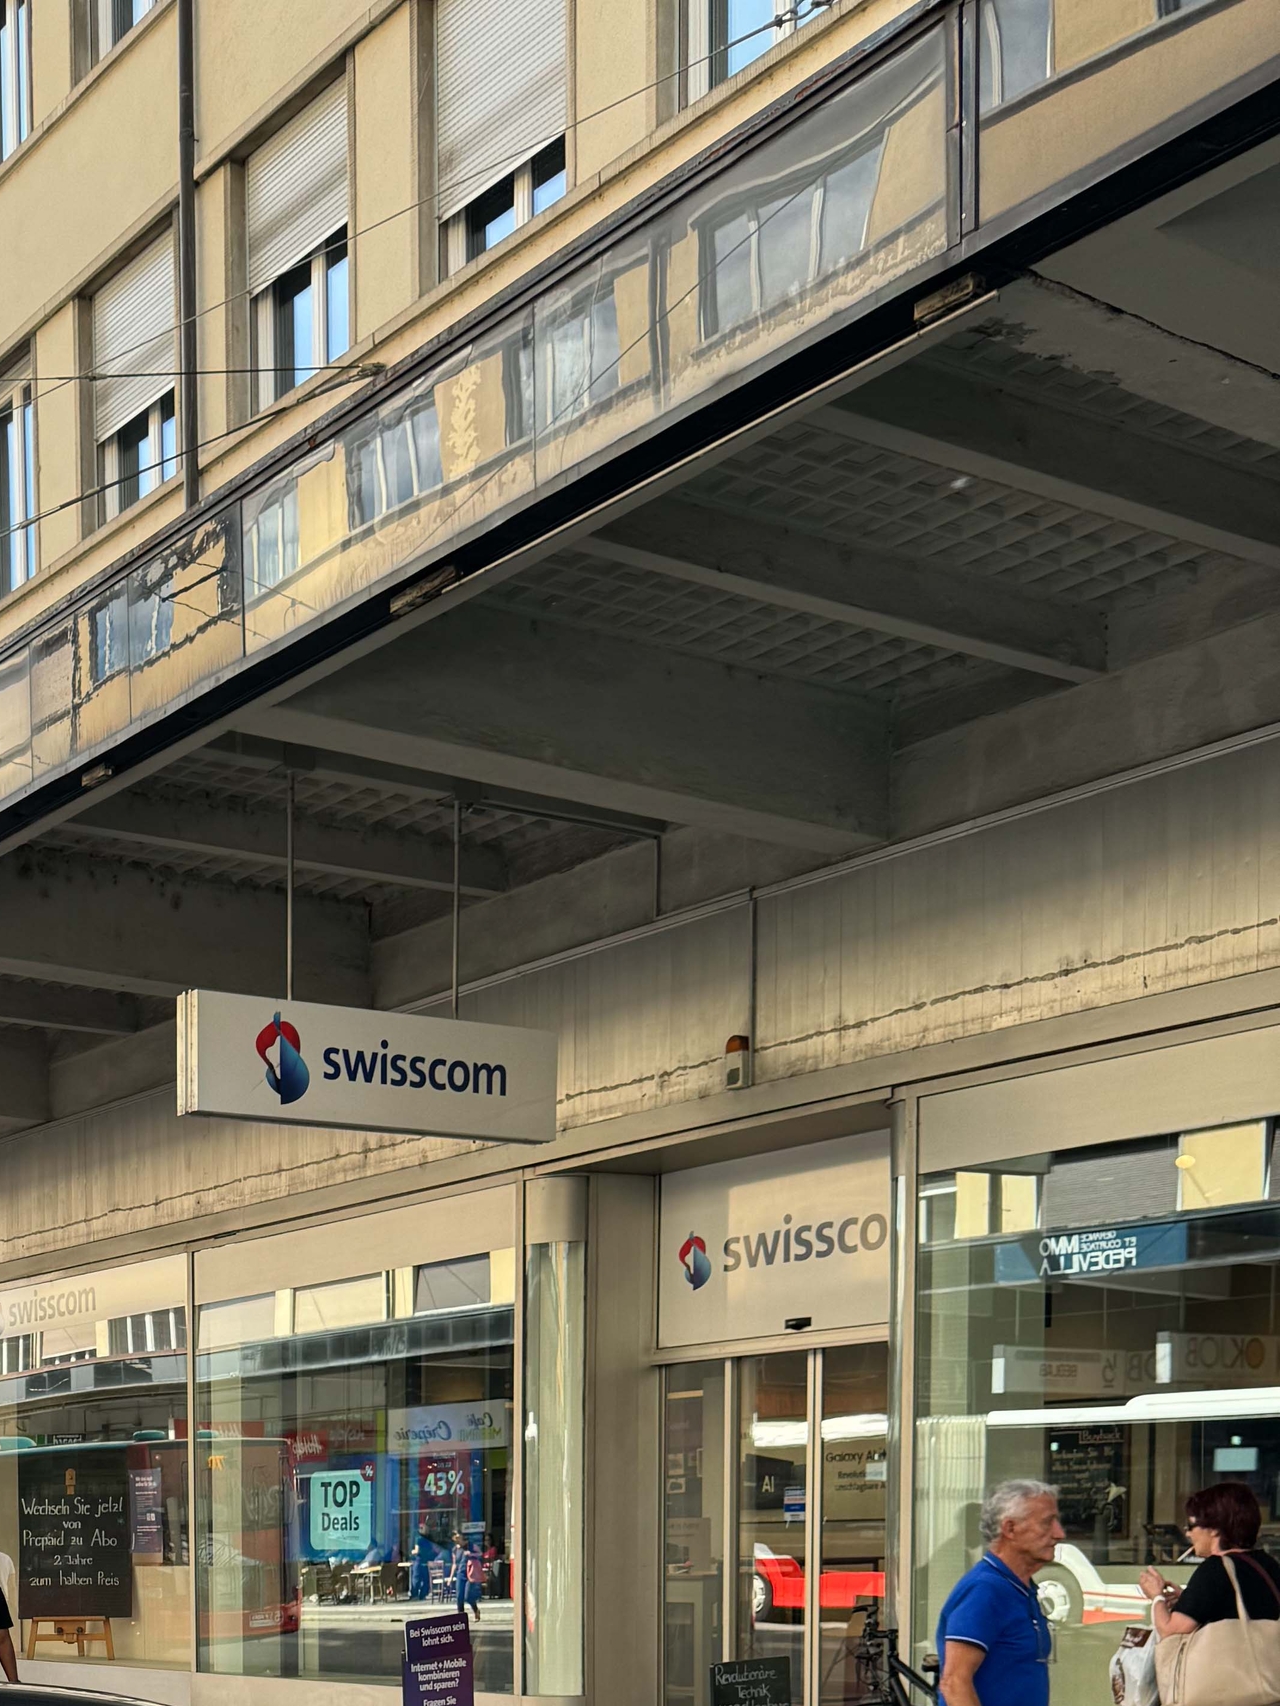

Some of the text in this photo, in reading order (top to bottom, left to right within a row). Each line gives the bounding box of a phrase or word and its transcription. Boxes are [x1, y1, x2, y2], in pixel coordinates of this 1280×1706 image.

[323, 1039, 507, 1096] swisscom
[723, 1213, 888, 1272] swissco
[9, 1287, 97, 1327] swisscom
[424, 1470, 464, 1496] 43%
[762, 1475, 775, 1492] AI
[320, 1480, 360, 1508] TOP
[74, 1496, 90, 1515] Sie
[95, 1496, 123, 1517] jetzt
[62, 1520, 81, 1529] von
[321, 1511, 360, 1531] Deals
[23, 1529, 64, 1551] Prepaid
[70, 1536, 83, 1546] zu
[90, 1528, 117, 1547] Abo
[64, 1554, 93, 1565] Jahre
[30, 1570, 120, 1586] zum halben Preis
[409, 1622, 466, 1638] Bei Swisscom sein
[422, 1634, 455, 1647] lohnt sich.
[411, 1661, 438, 1673] Internet
[443, 1657, 467, 1669] Mobile
[418, 1669, 460, 1682] kombinieren
[420, 1679, 459, 1692] und sparen?
[734, 1683, 771, 1699] Technik
[446, 1695, 456, 1706] Sie
